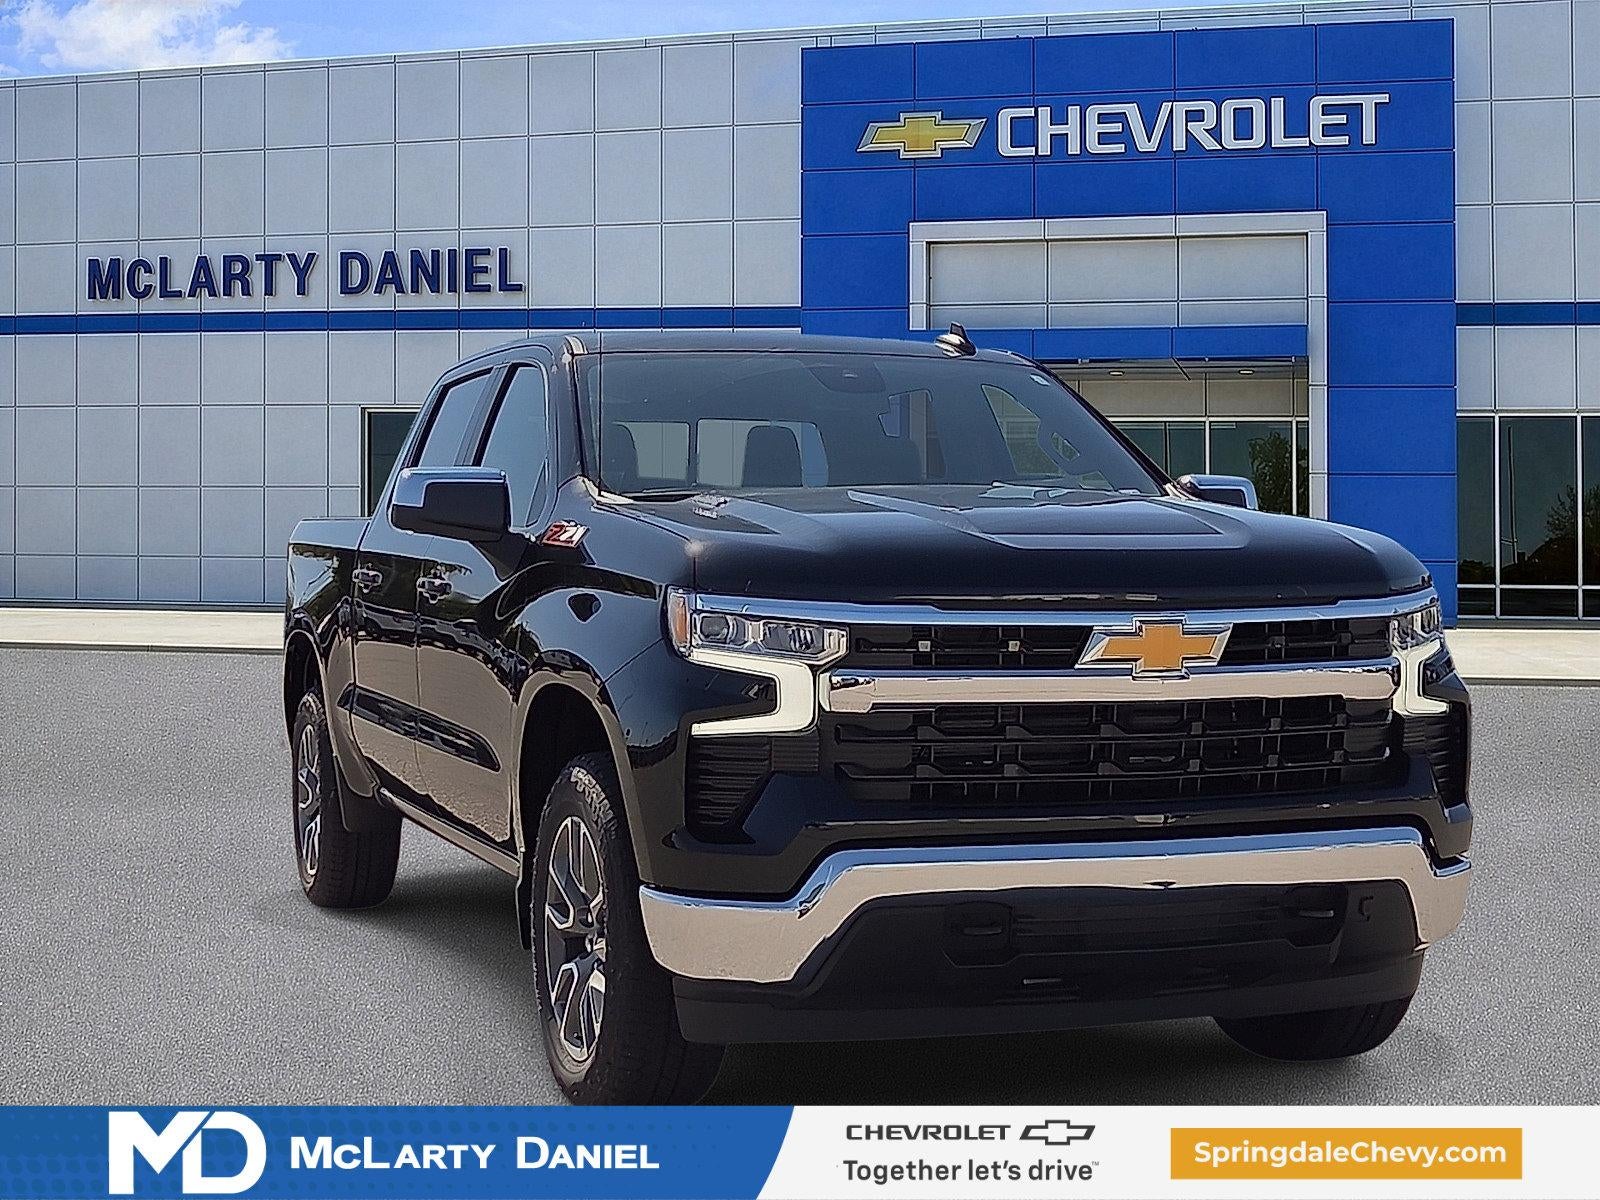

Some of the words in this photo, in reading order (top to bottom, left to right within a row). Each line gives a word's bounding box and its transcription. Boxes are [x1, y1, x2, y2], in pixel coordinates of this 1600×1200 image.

[997, 93, 1390, 157] CHEVROLET
[87, 252, 317, 300] MCLARTY
[339, 246, 524, 295] DANIEL
